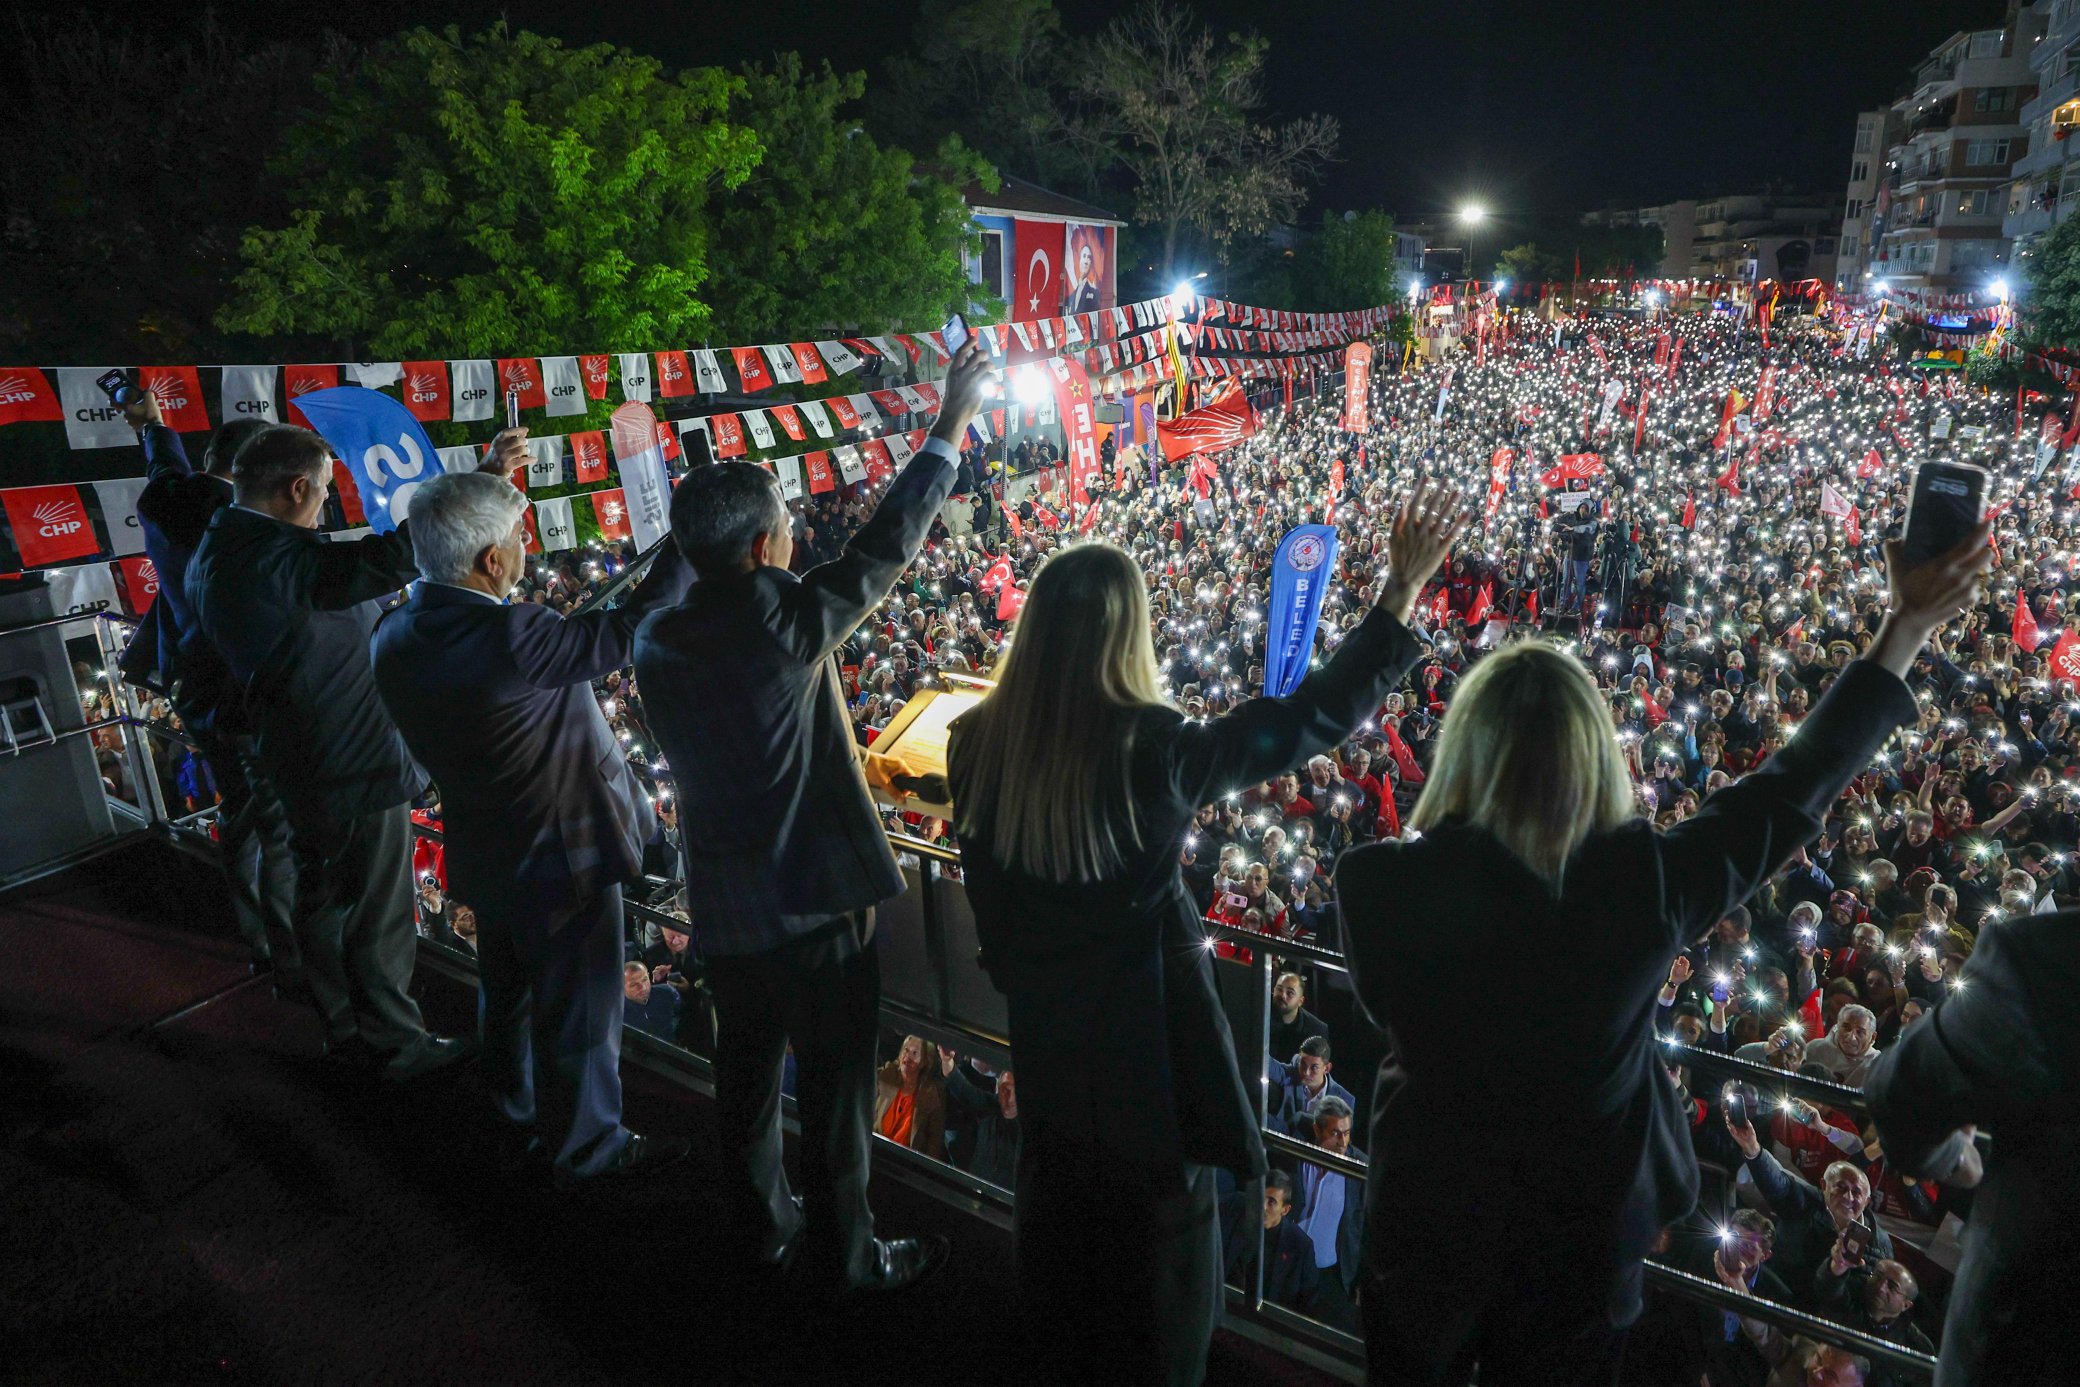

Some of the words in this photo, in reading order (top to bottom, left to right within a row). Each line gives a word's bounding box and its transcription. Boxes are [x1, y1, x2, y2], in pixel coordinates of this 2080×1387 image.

[833, 354, 848, 363] CHP
[778, 361, 792, 370] CHP
[804, 363, 819, 371] CHP
[664, 371, 682, 380] CHP
[744, 370, 760, 379] CHP
[509, 381, 533, 392] CHP
[552, 385, 576, 396] CHP
[412, 392, 438, 402] CHP
[461, 389, 488, 401] CHP
[235, 400, 269, 413] CHP
[858, 411, 872, 421] HP
[722, 435, 738, 444] CHP
[897, 450, 910, 460] CHP
[533, 462, 555, 473] CHP
[581, 459, 599, 468] CHP
[813, 473, 826, 481] CHP
[784, 479, 796, 489] CHP
[605, 516, 621, 525] CHP
[39, 521, 81, 537] CHP
[547, 526, 567, 537] CHP
[2059, 655, 2080, 676] CHP
